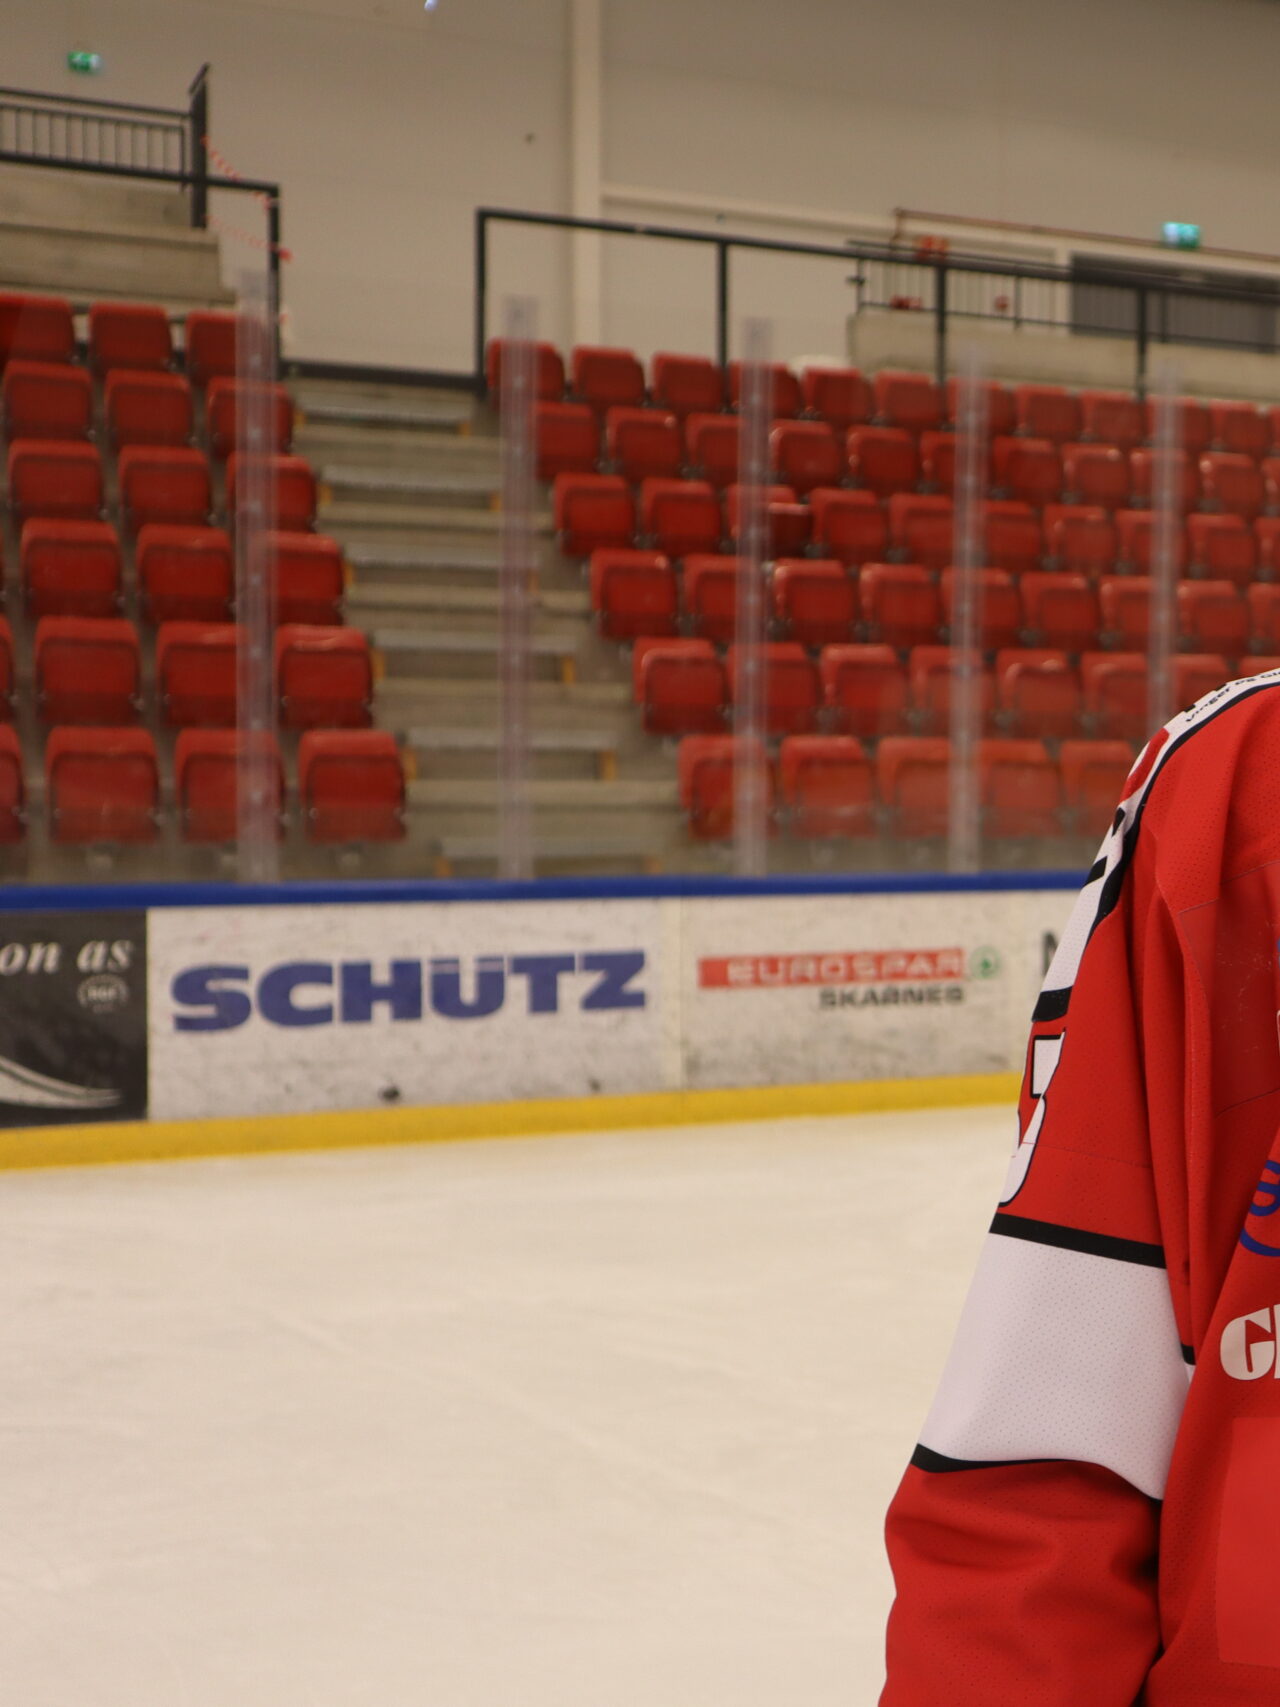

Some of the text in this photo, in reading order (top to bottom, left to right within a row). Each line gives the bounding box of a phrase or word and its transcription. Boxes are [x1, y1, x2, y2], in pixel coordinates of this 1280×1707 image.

[76, 939, 136, 973] as
[728, 949, 963, 986] EUROSPAR
[170, 949, 647, 1032] SCHÜTZ
[818, 984, 966, 1010] SKARNES
